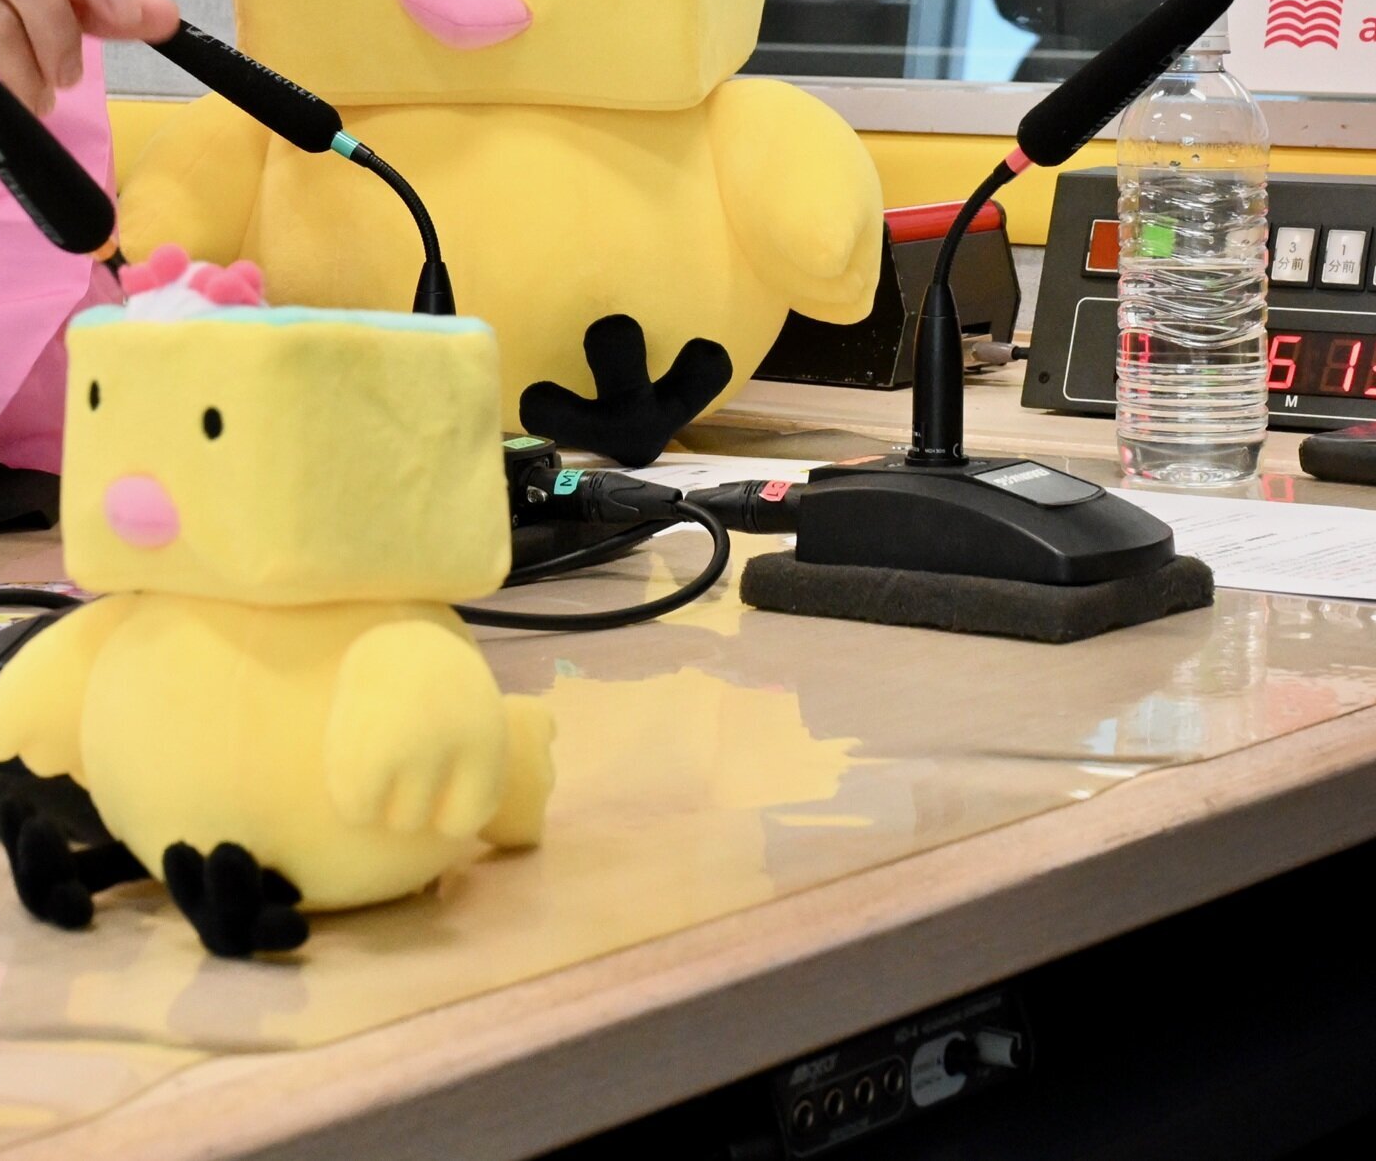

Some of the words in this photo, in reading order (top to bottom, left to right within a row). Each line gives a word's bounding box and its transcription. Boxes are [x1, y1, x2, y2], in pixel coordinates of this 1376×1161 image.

[1289, 242, 1297, 254] 3
[1341, 244, 1346, 256] 1
[1279, 258, 1304, 271] 分前
[1327, 259, 1355, 274] 分前
[1284, 395, 1298, 408] M
